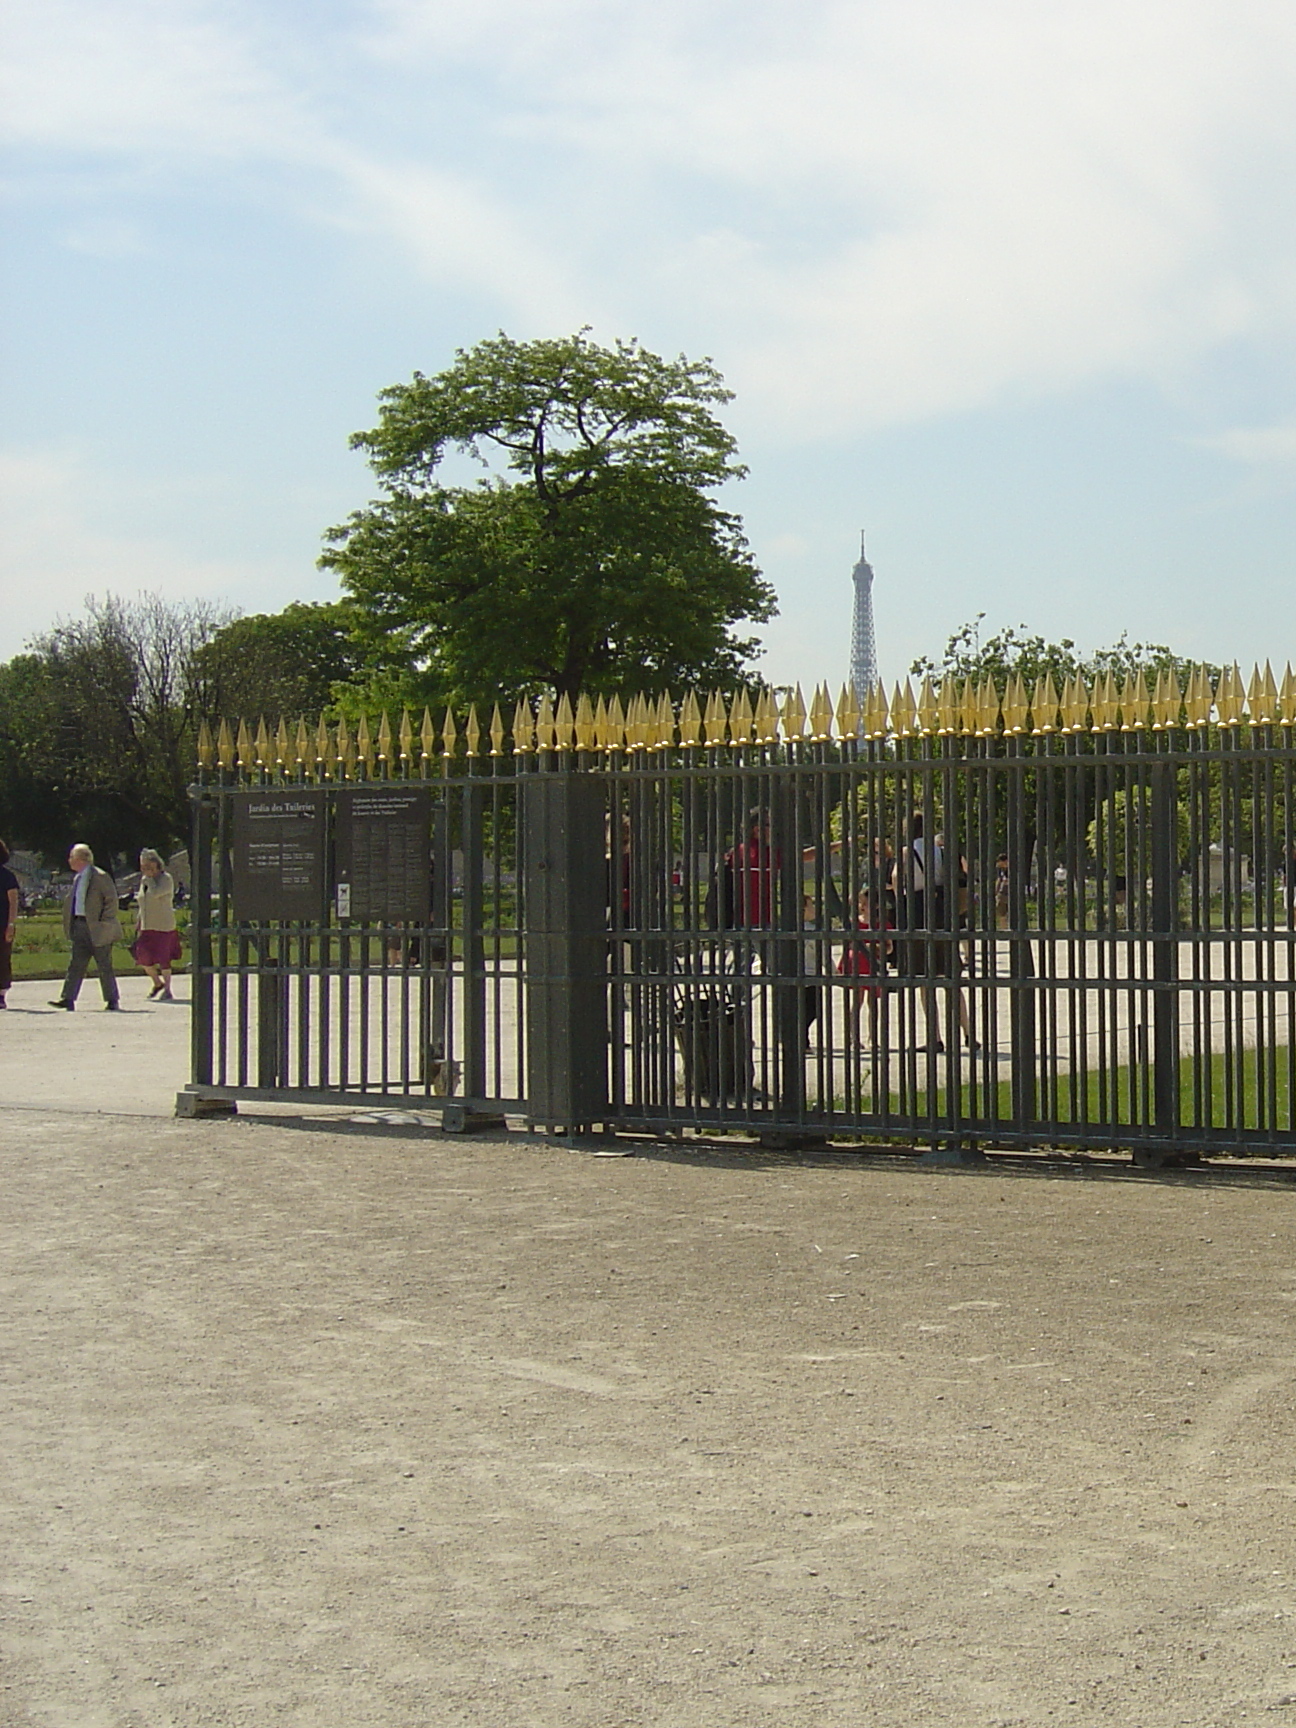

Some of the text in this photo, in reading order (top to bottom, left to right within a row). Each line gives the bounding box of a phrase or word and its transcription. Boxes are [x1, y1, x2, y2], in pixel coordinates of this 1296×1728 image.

[248, 802, 315, 814] Jardin des Tuileries
